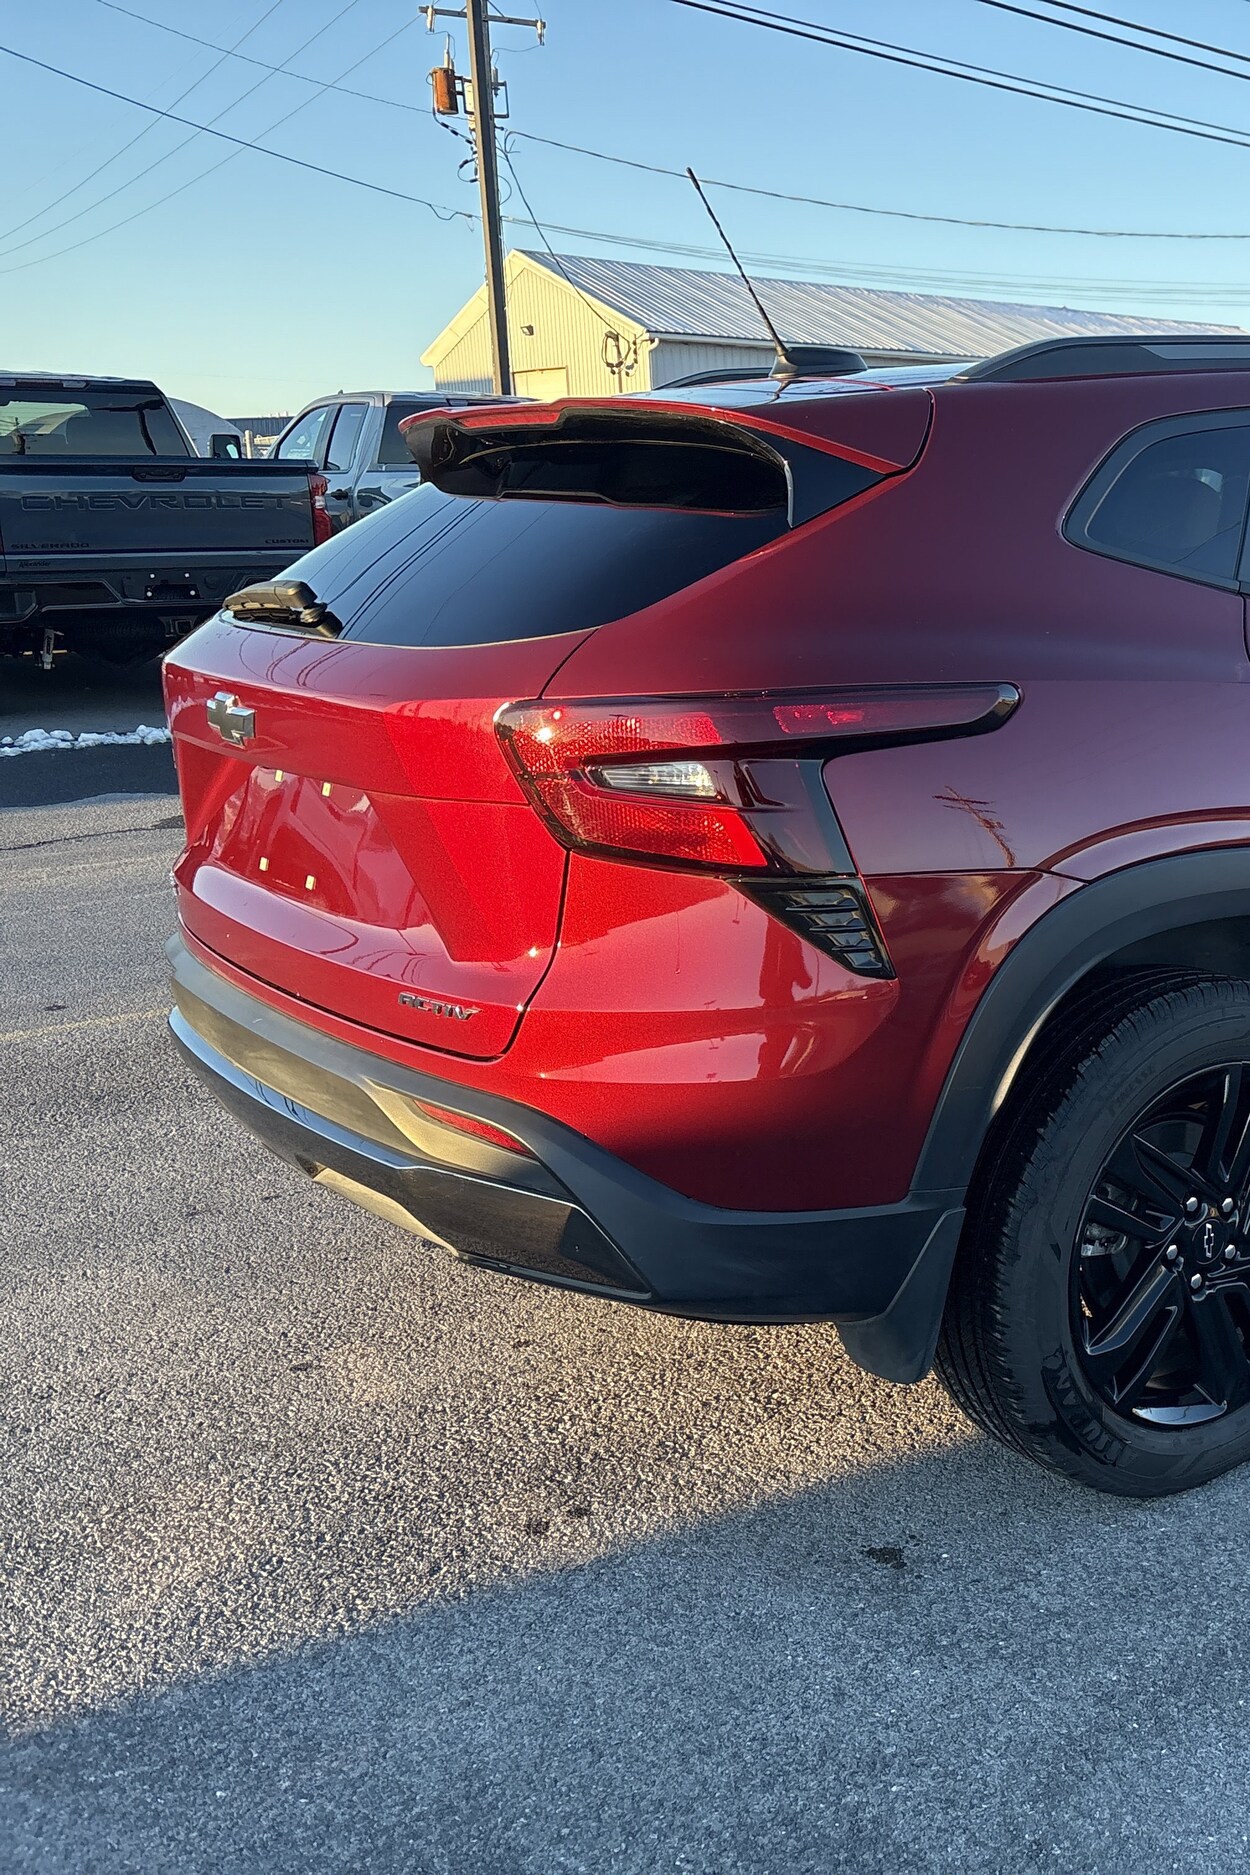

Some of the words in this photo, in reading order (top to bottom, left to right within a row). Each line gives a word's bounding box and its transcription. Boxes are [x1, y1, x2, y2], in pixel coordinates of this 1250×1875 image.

[20, 495, 291, 511] CHEVROLET
[10, 542, 90, 550] SILVERADO
[398, 991, 484, 1021] ACTIV
